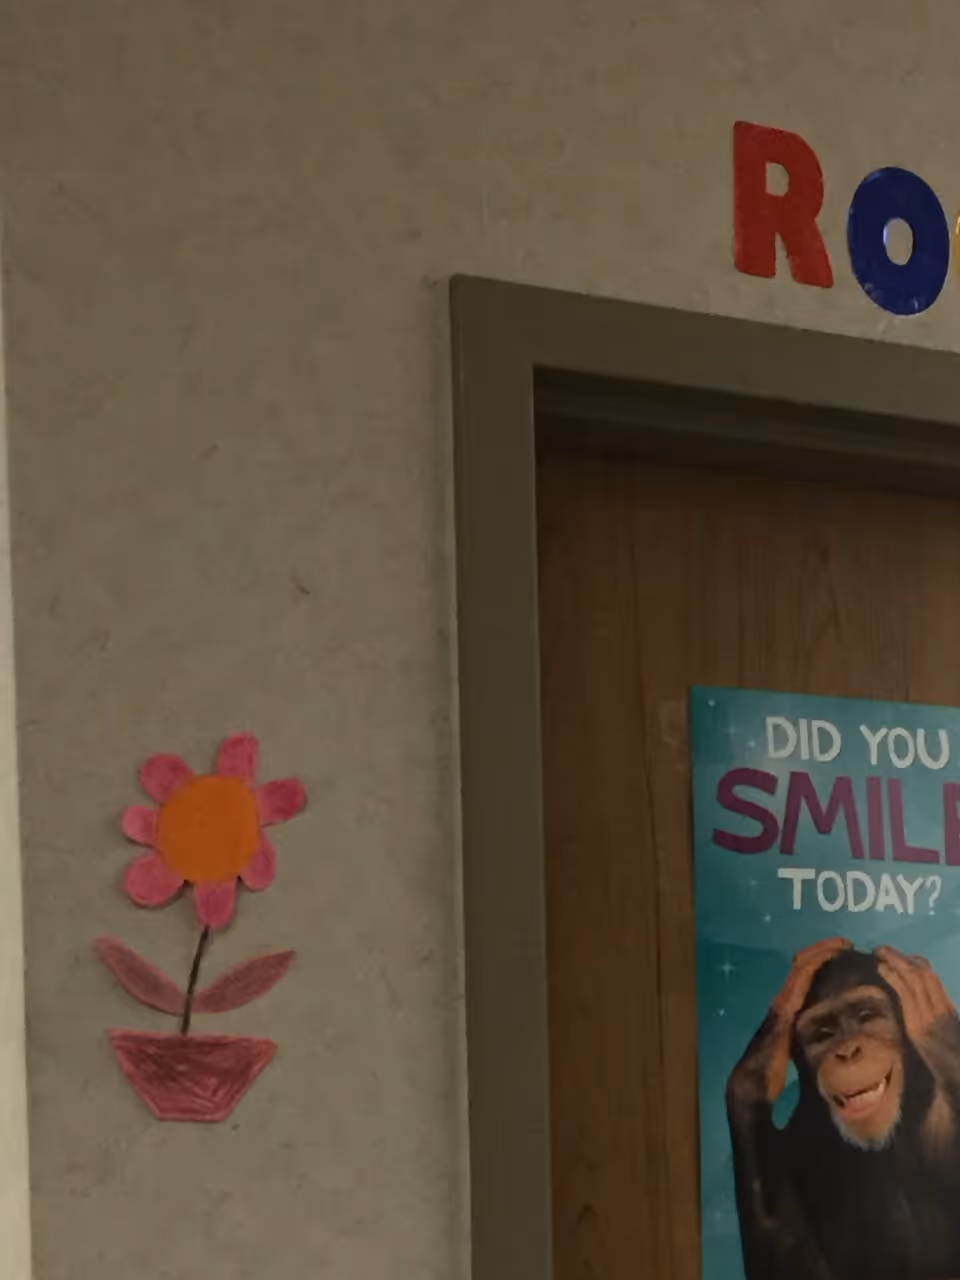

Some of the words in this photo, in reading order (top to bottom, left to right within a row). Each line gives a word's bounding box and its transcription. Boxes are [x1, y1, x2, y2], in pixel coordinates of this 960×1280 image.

[766, 716, 841, 762] DID
[859, 724, 950, 769] YOU
[777, 867, 943, 915] TODAY?
